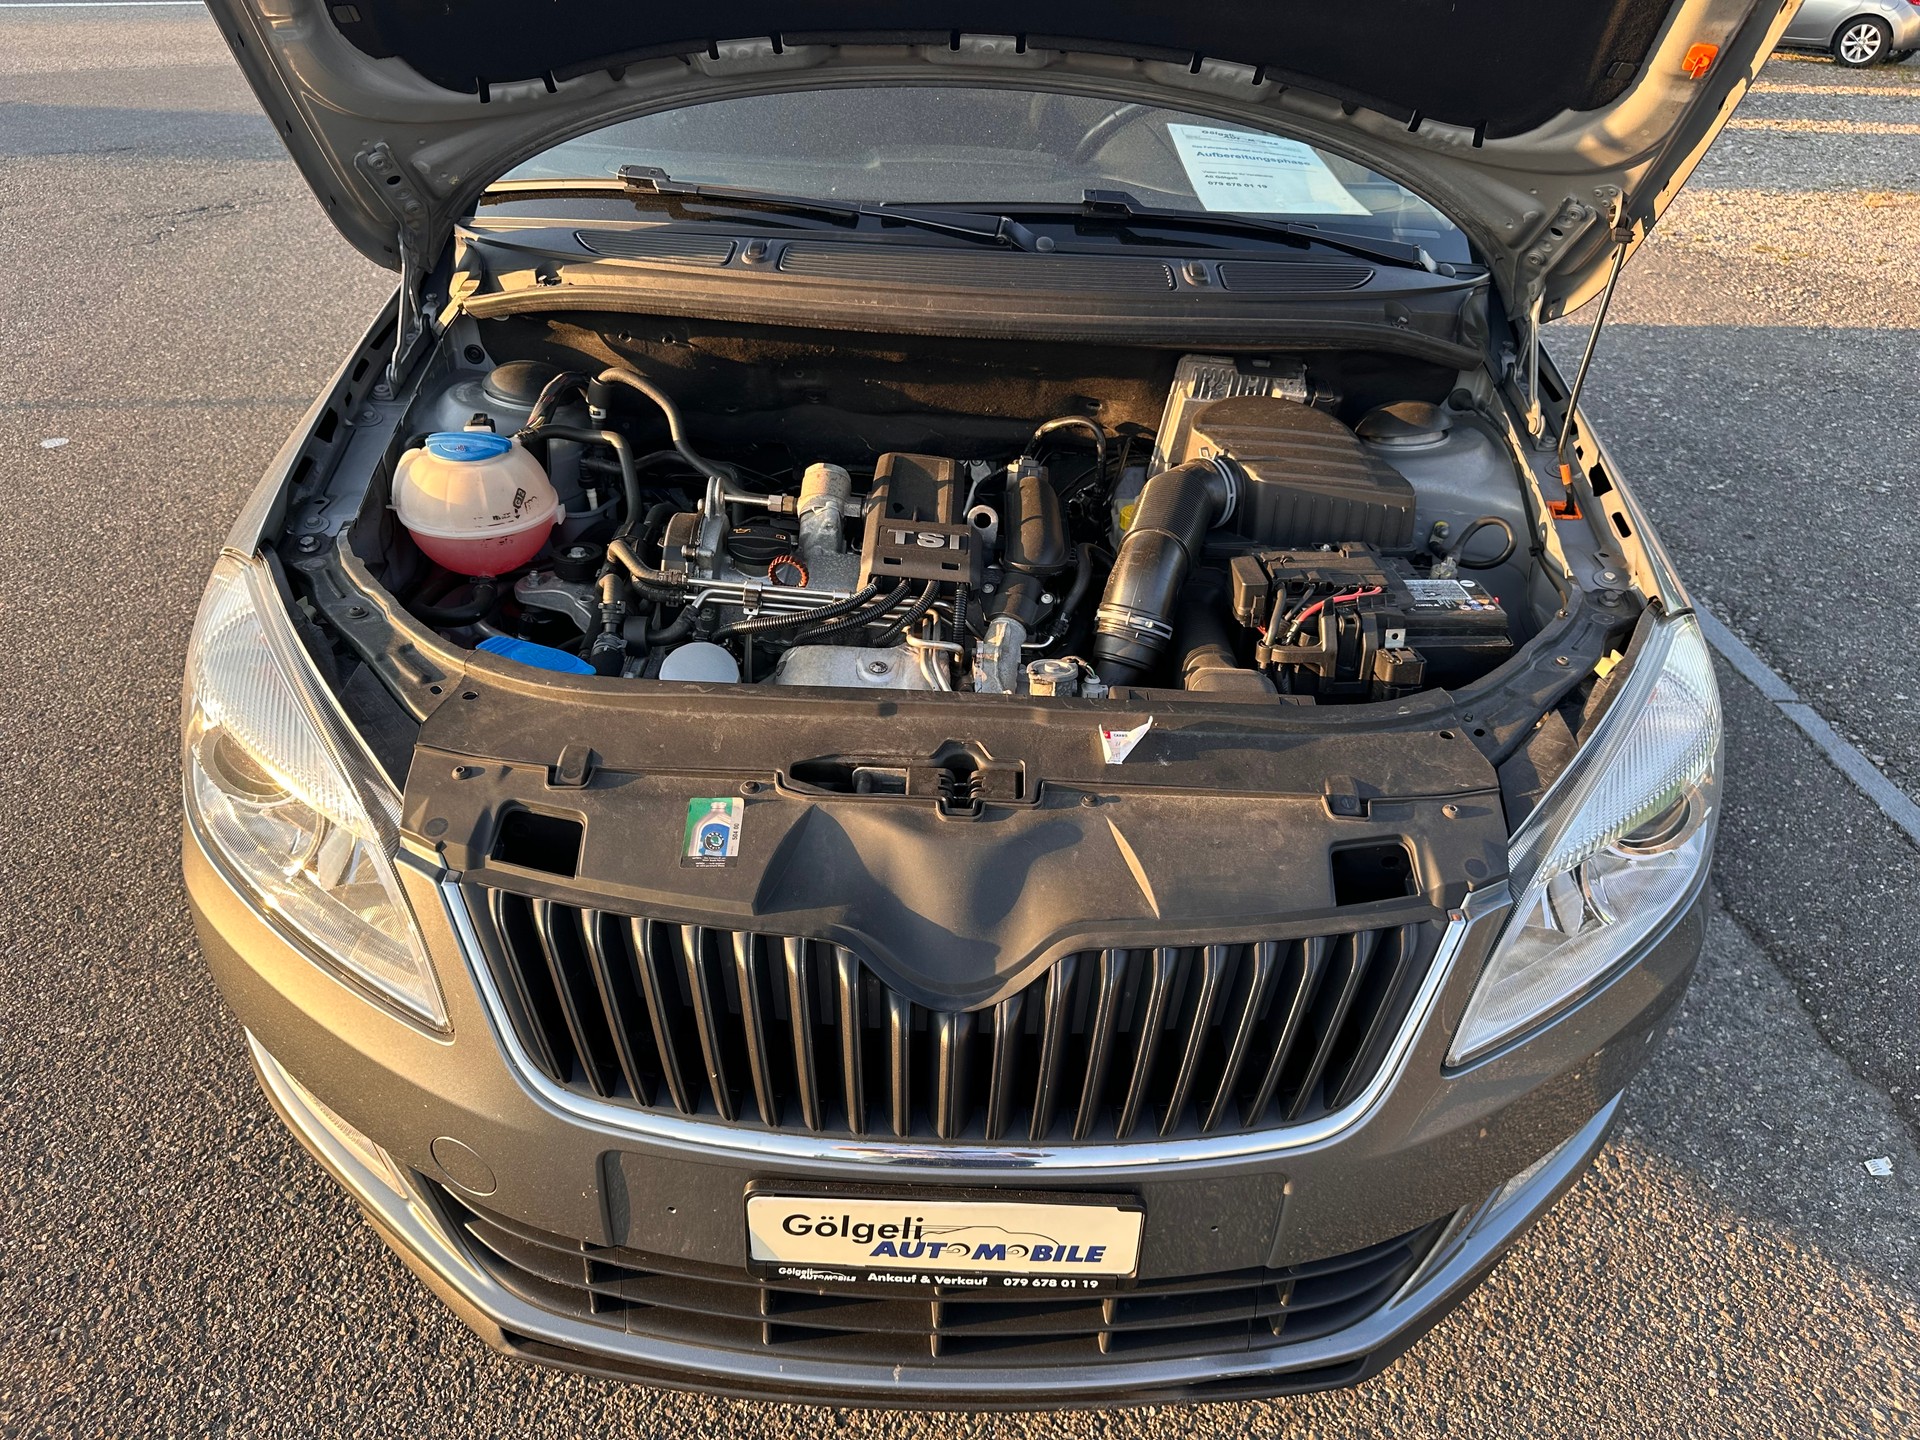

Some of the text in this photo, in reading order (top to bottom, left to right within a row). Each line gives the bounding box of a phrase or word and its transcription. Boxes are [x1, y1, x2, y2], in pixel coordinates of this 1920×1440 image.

[1196, 151, 1311, 166] Aufbereitungsphase
[886, 528, 960, 550] TSI
[782, 1213, 924, 1244] Gölgeli
[778, 1267, 813, 1277] Gölgeli
[867, 1272, 1099, 1289] Ankauf & Verkauf 079 678 01 19
